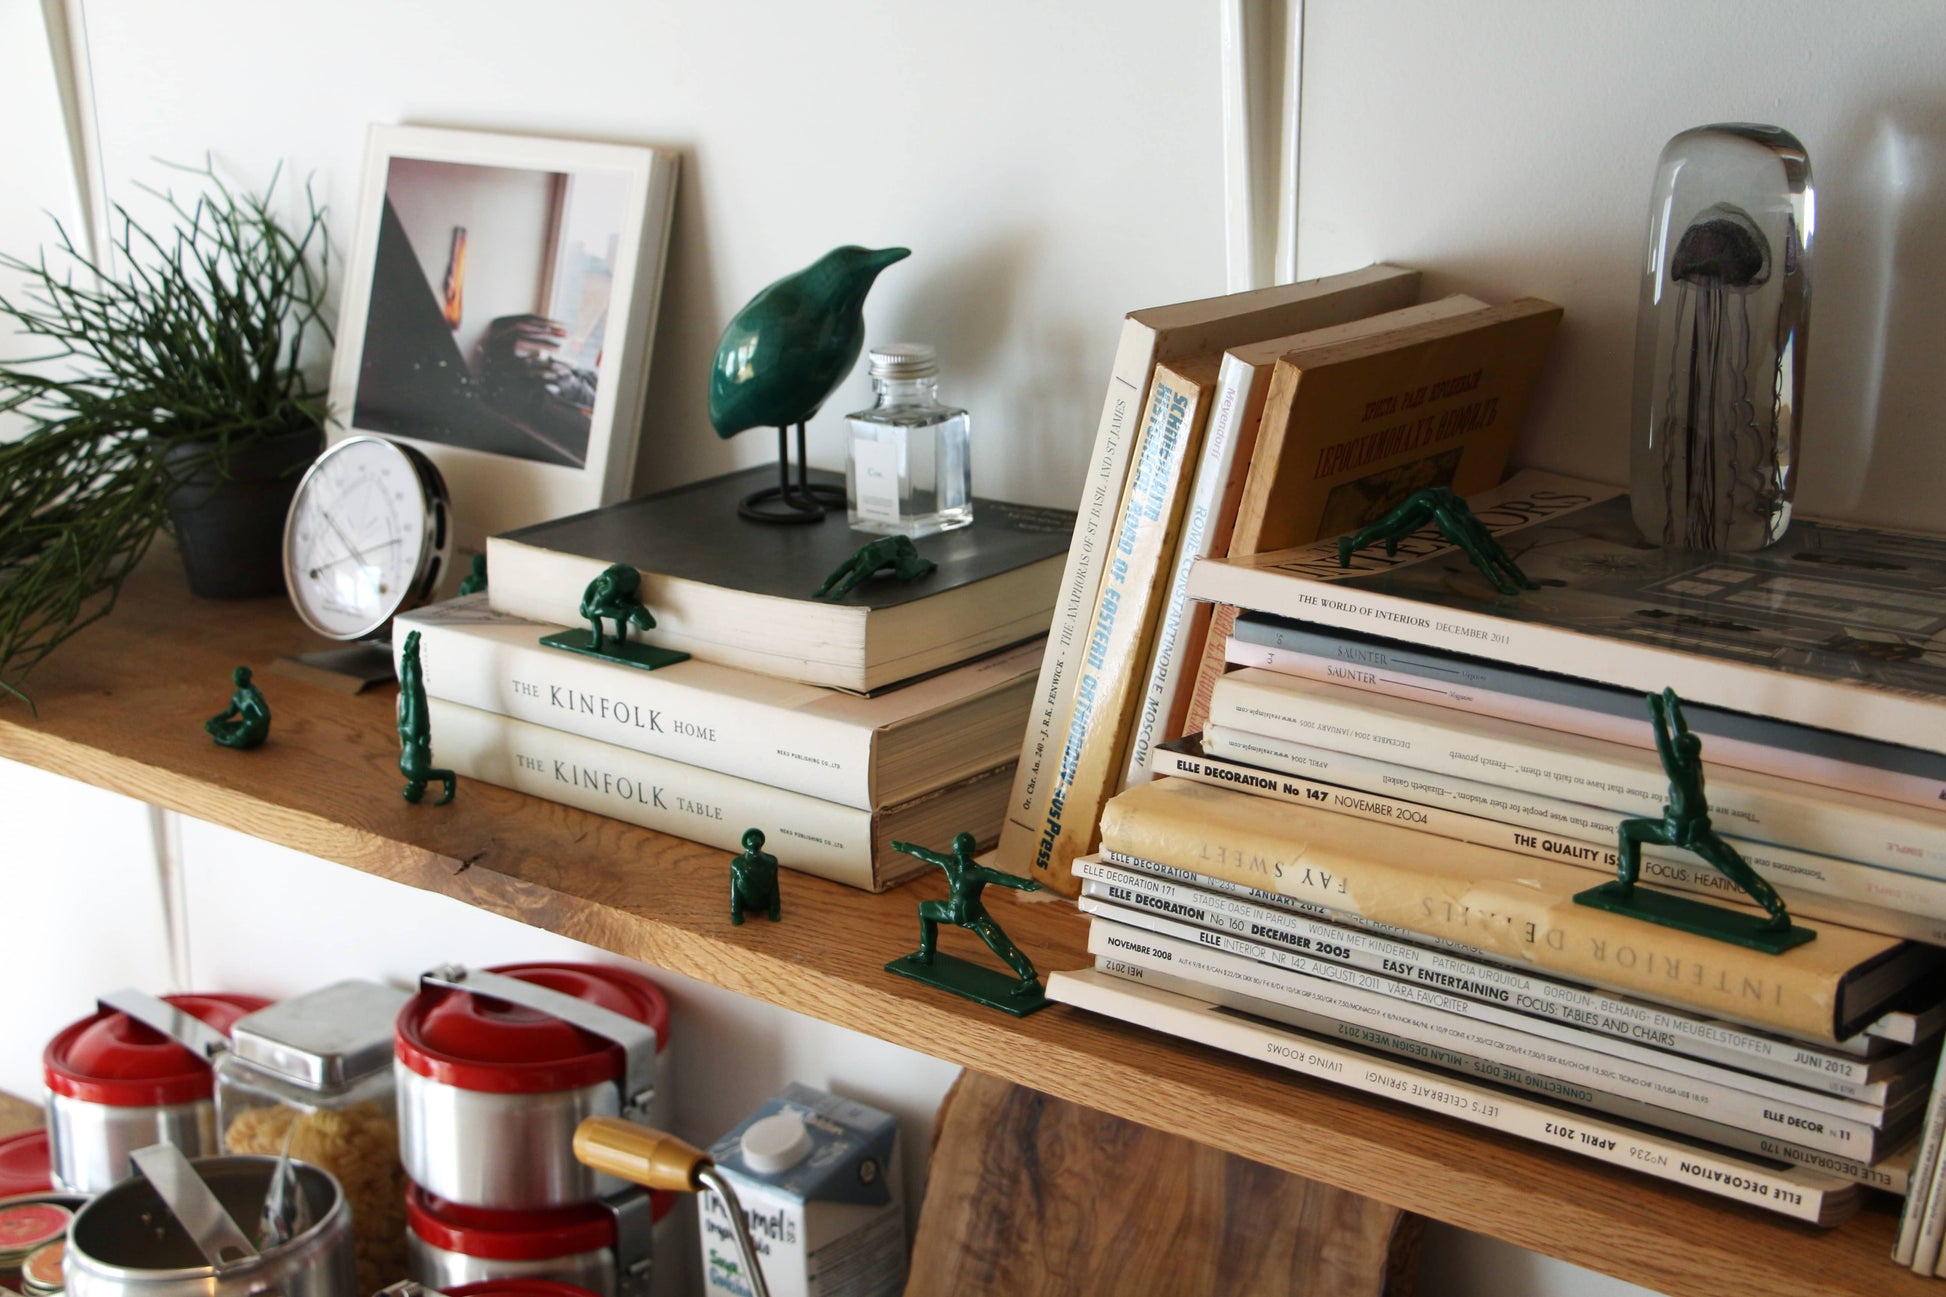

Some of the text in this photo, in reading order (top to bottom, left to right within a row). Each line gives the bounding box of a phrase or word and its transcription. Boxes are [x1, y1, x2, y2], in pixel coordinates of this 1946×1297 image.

[1109, 398, 1127, 439] JAMES
[1212, 387, 1235, 460] Meyendorff
[1105, 437, 1116, 455] ST
[1099, 455, 1112, 481] AND
[1086, 518, 1097, 536] ST
[1264, 491, 1592, 578] INTERORS
[1082, 535, 1094, 553] OF
[1111, 557, 1127, 584] OF
[1066, 552, 1090, 621] ANAPHORAS
[1088, 586, 1120, 671] EASTERN
[1299, 593, 1510, 645] THE WORLD OF INTERIORS DECEMBER 2011
[1059, 621, 1073, 648] THE
[1337, 646, 1388, 665] SAUNTER
[1047, 659, 1063, 705] FENWICK
[1327, 665, 1376, 685] SAUNTER
[512, 680, 717, 741] THE KINFOLK HOME
[1136, 697, 1158, 767] MOSCOW
[1298, 718, 1315, 729] 2005
[1316, 722, 1350, 736] JANUARY
[1354, 730, 1370, 740] 2004
[1371, 734, 1410, 748] DECEMBER
[1035, 741, 1044, 758] 240
[1227, 739, 1328, 768] APRIL 2004 www.realsimple.com
[1448, 747, 1479, 764] proverb
[1031, 757, 1040, 775] An.
[1542, 769, 1551, 780] in
[515, 754, 723, 821] THE KINFOLK TABLE
[1026, 774, 1036, 795] Chr.
[1381, 775, 1409, 788] Gaskell
[1552, 771, 1572, 784] faith
[1573, 775, 1584, 784] no
[1586, 778, 1605, 790] have
[1176, 759, 1427, 824] ELLE DECORATION No 147 NOVEMBER 2004
[1606, 782, 1624, 794] that
[1625, 787, 1648, 799] those
[1649, 793, 1662, 802] for
[1022, 794, 1031, 811] Or.
[1489, 799, 1508, 810] their
[1509, 803, 1520, 812] for
[1521, 803, 1548, 819] people
[1548, 811, 1567, 823] wise
[1568, 816, 1588, 828] than
[1589, 821, 1614, 834] better
[1036, 818, 1061, 870] Press
[1513, 832, 1537, 848] THE
[1541, 838, 1599, 862] QUALITY
[1110, 851, 1129, 864] ELLE
[1133, 857, 1197, 881] DECORATION
[1200, 843, 1347, 894] FAY SWEET
[1645, 861, 1689, 882] FOCUS:
[1754, 857, 1770, 866] one
[1108, 936, 1172, 960] NOVEMBRE 2008
[1083, 864, 1103, 877] ELLE
[1106, 870, 1159, 892] DECORATION
[1161, 884, 1174, 896] 171
[1192, 893, 1226, 910] STADSE
[1253, 908, 1263, 920] IN
[1265, 911, 1296, 929] PARIJS
[1308, 923, 1344, 941] WONEN
[1346, 932, 1366, 947] MET
[1368, 939, 1419, 962] KINDEREN
[1432, 955, 1476, 976] PATRICIA
[1478, 967, 1530, 991] URQUIOLA
[1654, 1014, 1670, 1028] EN
[1672, 1019, 1771, 1054] MEUBELSTOFFEN
[1793, 1050, 1822, 1069] JUNI
[1825, 1059, 1852, 1076] 2012
[1105, 960, 1143, 977] MEI 2012
[1109, 885, 1675, 1047] ELLE DECORATION No 160 DECEMBER 2005 EASY ENTERTAINING FOCUS: TABLES AND CHAIRS
[1199, 931, 1220, 947] ELLE
[1271, 951, 1286, 964] NR
[1290, 955, 1305, 970] 142
[1311, 961, 1356, 983] AUGUSTI
[1358, 973, 1379, 989] 2011
[1416, 989, 1468, 1013] FAVORITER
[1591, 939, 1782, 1005] INTERIOR
[1265, 1041, 1304, 1062] ROOMS
[1306, 1053, 1342, 1073] LIVING
[1337, 1023, 1592, 1101] CONNECTING THE DOTS MILAN DESIGN WEEK 2012
[1411, 1083, 1468, 1108] CELEBRATE
[1471, 1100, 1498, 1117] LET'S
[1544, 1122, 1574, 1139] 2012
[1763, 1109, 1784, 1123] ELLE
[1786, 1115, 1824, 1134] DECOR
[1579, 1132, 1616, 1151] APRIL
[1759, 1140, 1891, 1184] ELLE DECORATION 170
[1679, 1161, 1767, 1195] DECORATION
[1773, 1187, 1801, 1205] ELLE
